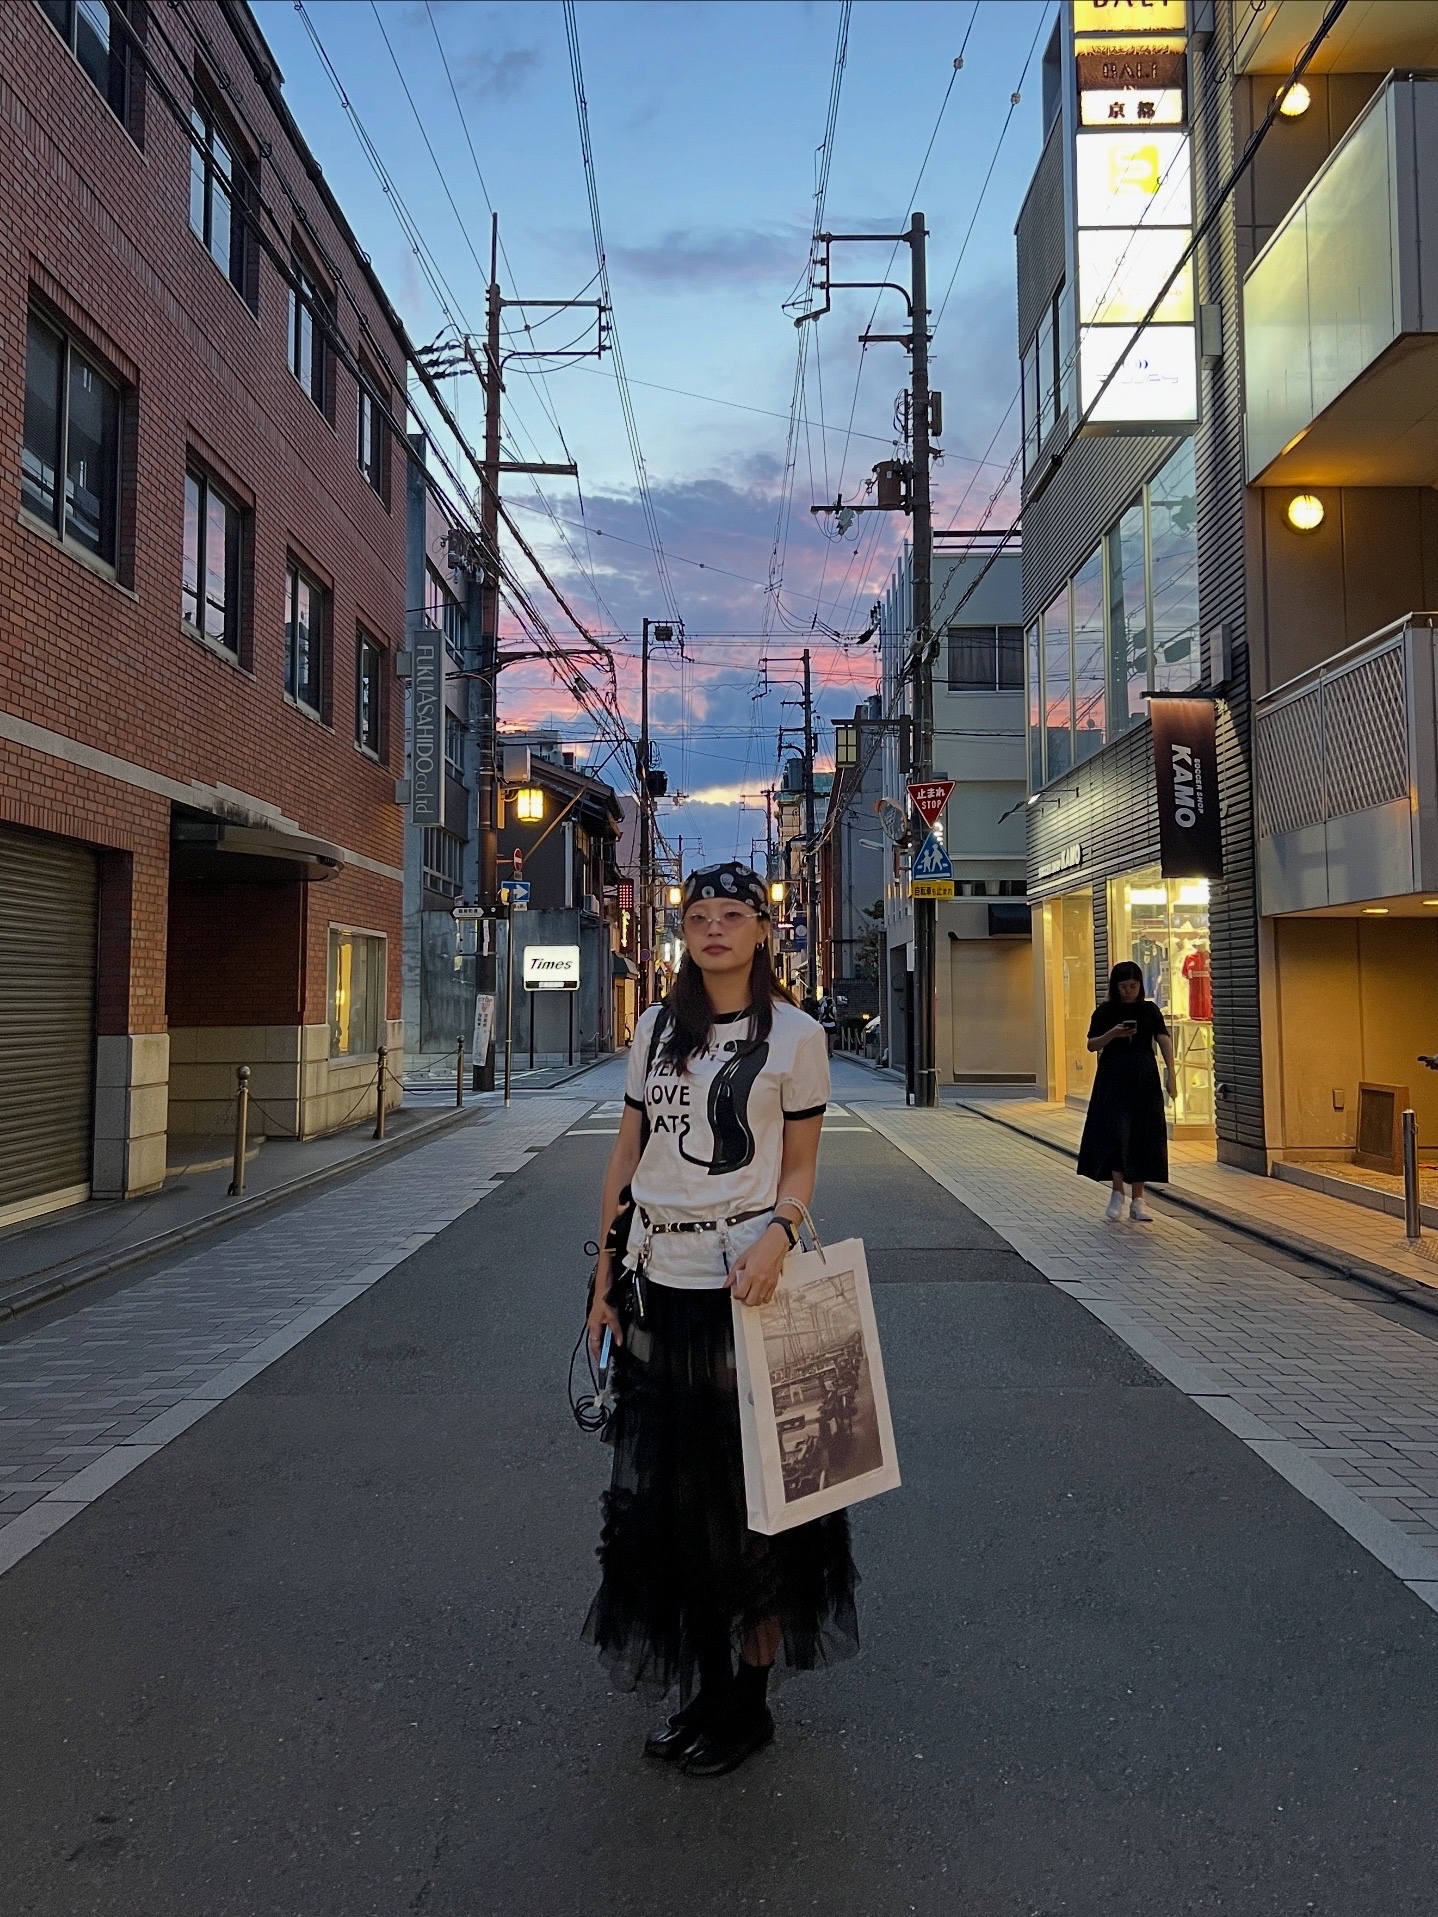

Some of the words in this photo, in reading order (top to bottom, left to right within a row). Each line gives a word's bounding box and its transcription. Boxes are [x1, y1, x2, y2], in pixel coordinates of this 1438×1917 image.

[1171, 743, 1196, 828] KAMO
[916, 786, 946, 800] 止まれ
[921, 800, 942, 810] STOP
[530, 958, 573, 970] Times
[651, 1114, 690, 1136] ATS
